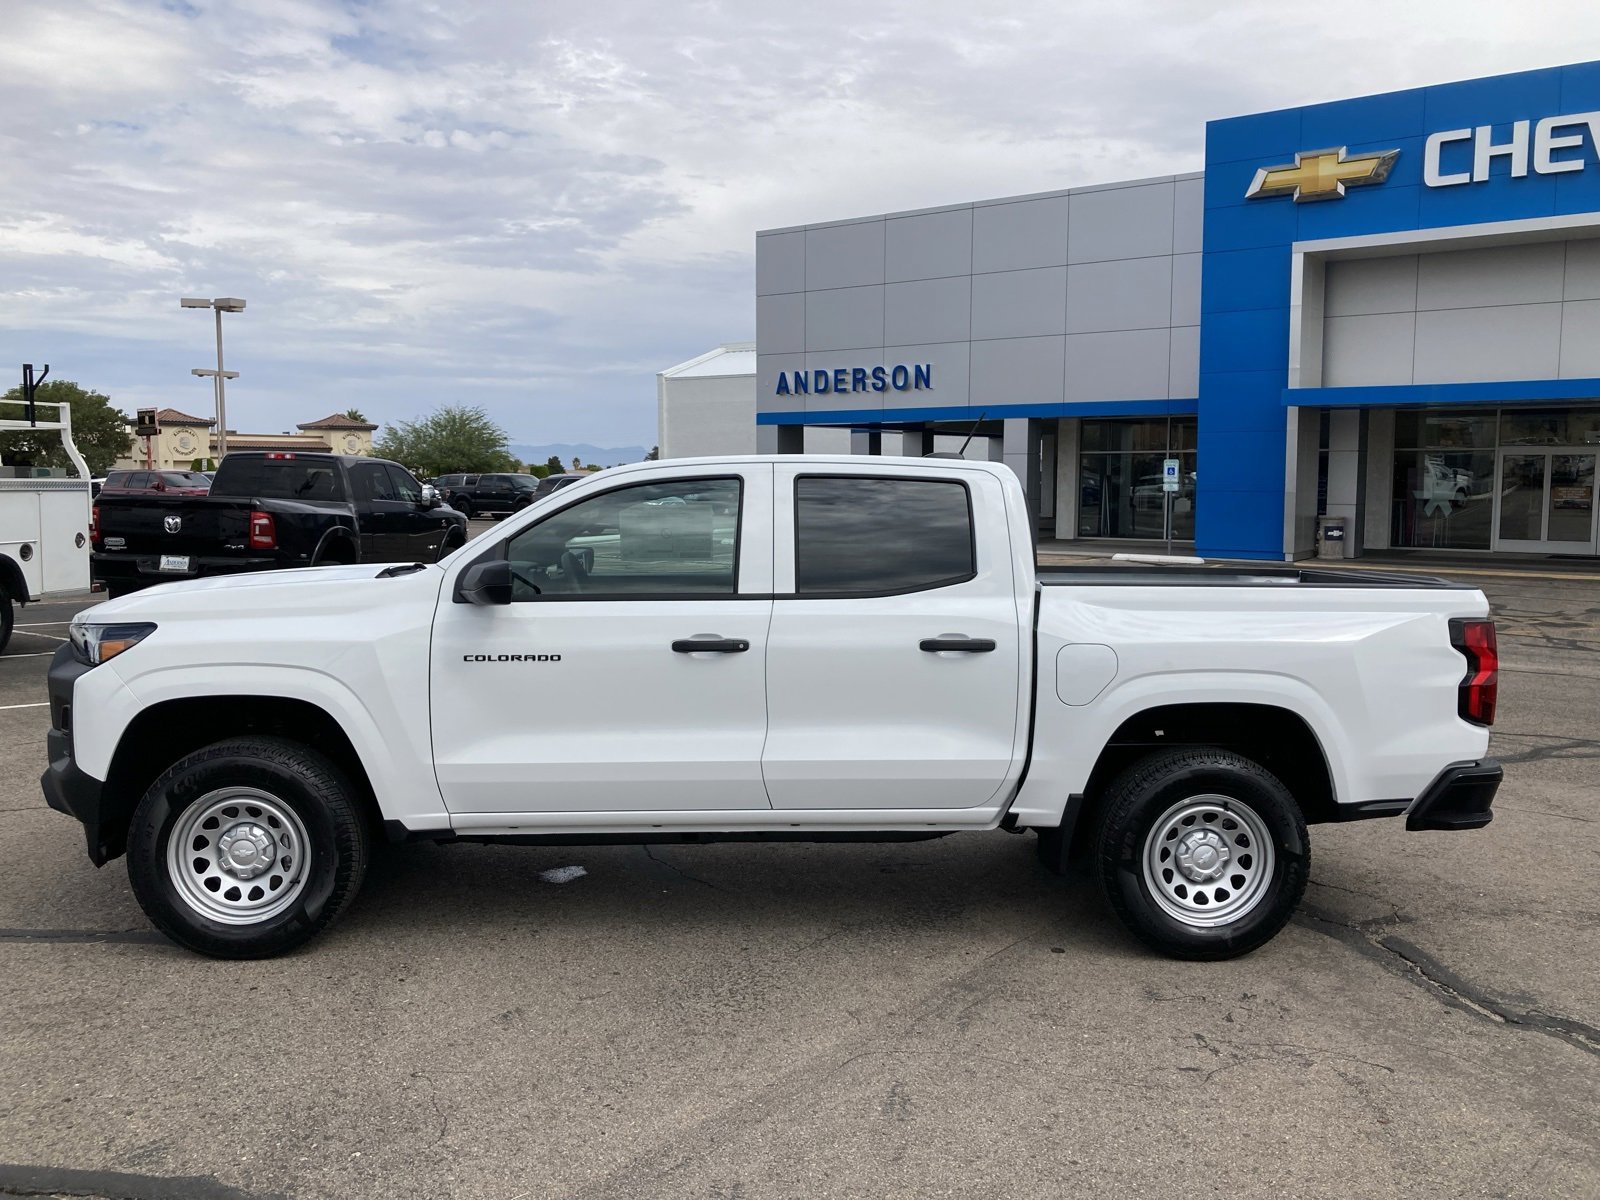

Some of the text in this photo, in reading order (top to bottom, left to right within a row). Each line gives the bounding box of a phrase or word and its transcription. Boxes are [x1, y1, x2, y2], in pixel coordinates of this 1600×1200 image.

[1424, 111, 1600, 187] CHE
[776, 363, 933, 395] ANDERSON
[463, 654, 562, 662] COLORADO
